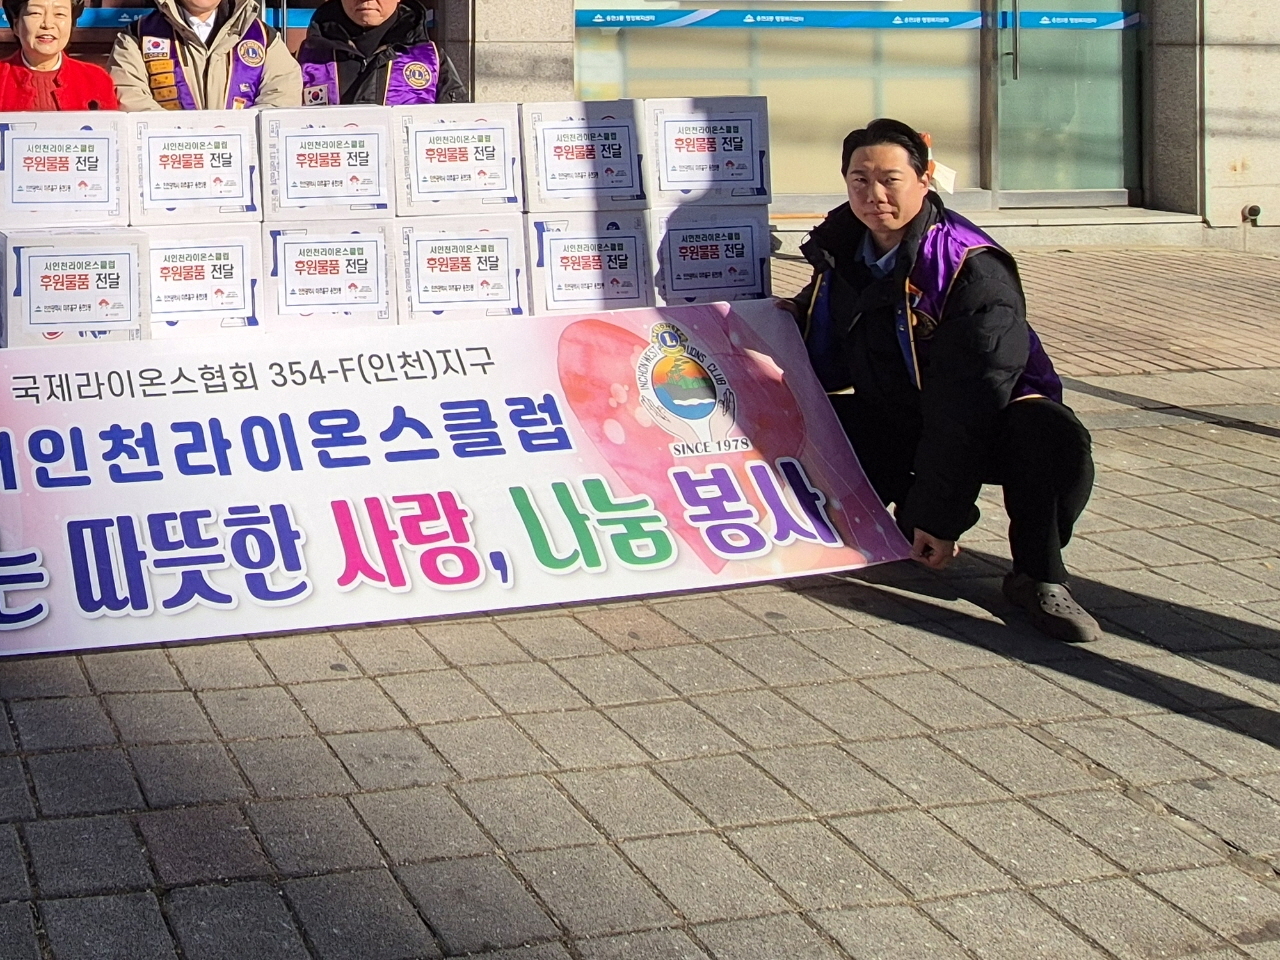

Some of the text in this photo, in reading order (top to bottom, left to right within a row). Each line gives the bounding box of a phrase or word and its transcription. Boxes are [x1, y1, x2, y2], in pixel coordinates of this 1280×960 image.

[556, 133, 617, 142] 서인천라이온스클럽
[678, 126, 739, 135] 서인천라이온스클럽
[163, 141, 228, 151] 서인천라이온스클럽
[300, 140, 365, 150] 서인천라이온스클럽
[429, 135, 491, 145] 서인천라이온스클럽
[675, 137, 744, 153] 후원물품 전달
[27, 144, 94, 153] 서인천라이온스클럽
[426, 146, 496, 163] 후원물품 전달
[553, 144, 622, 160] 후원물품 전달
[23, 156, 99, 172] 후원물품 전달
[159, 152, 233, 170] 후원물품 전달
[296, 152, 369, 169] 후원물품 전달
[682, 232, 740, 243] 서인천라이온스클럽
[299, 247, 363, 257] 서인천라이온스클럽
[431, 245, 495, 254] 서인천라이온스클럽
[563, 243, 623, 253] 서인천라이온스클럽
[679, 243, 745, 261] 후원물품 전달
[164, 252, 229, 263] 서인천라이온스클럽
[427, 256, 499, 273] 후원물품 전달
[560, 254, 628, 271] 후원물품 전달
[45, 261, 115, 271] 서인천라이온스클럽
[160, 264, 234, 282] 후원물품 전달
[295, 259, 368, 275] 후원물품 전달
[40, 273, 120, 291] 후원물품 전달
[12, 346, 496, 404] 국제라이온스협회 354-F(인천)지구
[706, 362, 727, 386] CLUB
[673, 438, 749, 456] SINCE 1978
[67, 504, 308, 615] 따뜻한
[331, 490, 509, 589] 사랑,
[509, 477, 670, 570] 나눔
[675, 459, 829, 556] 봉사
